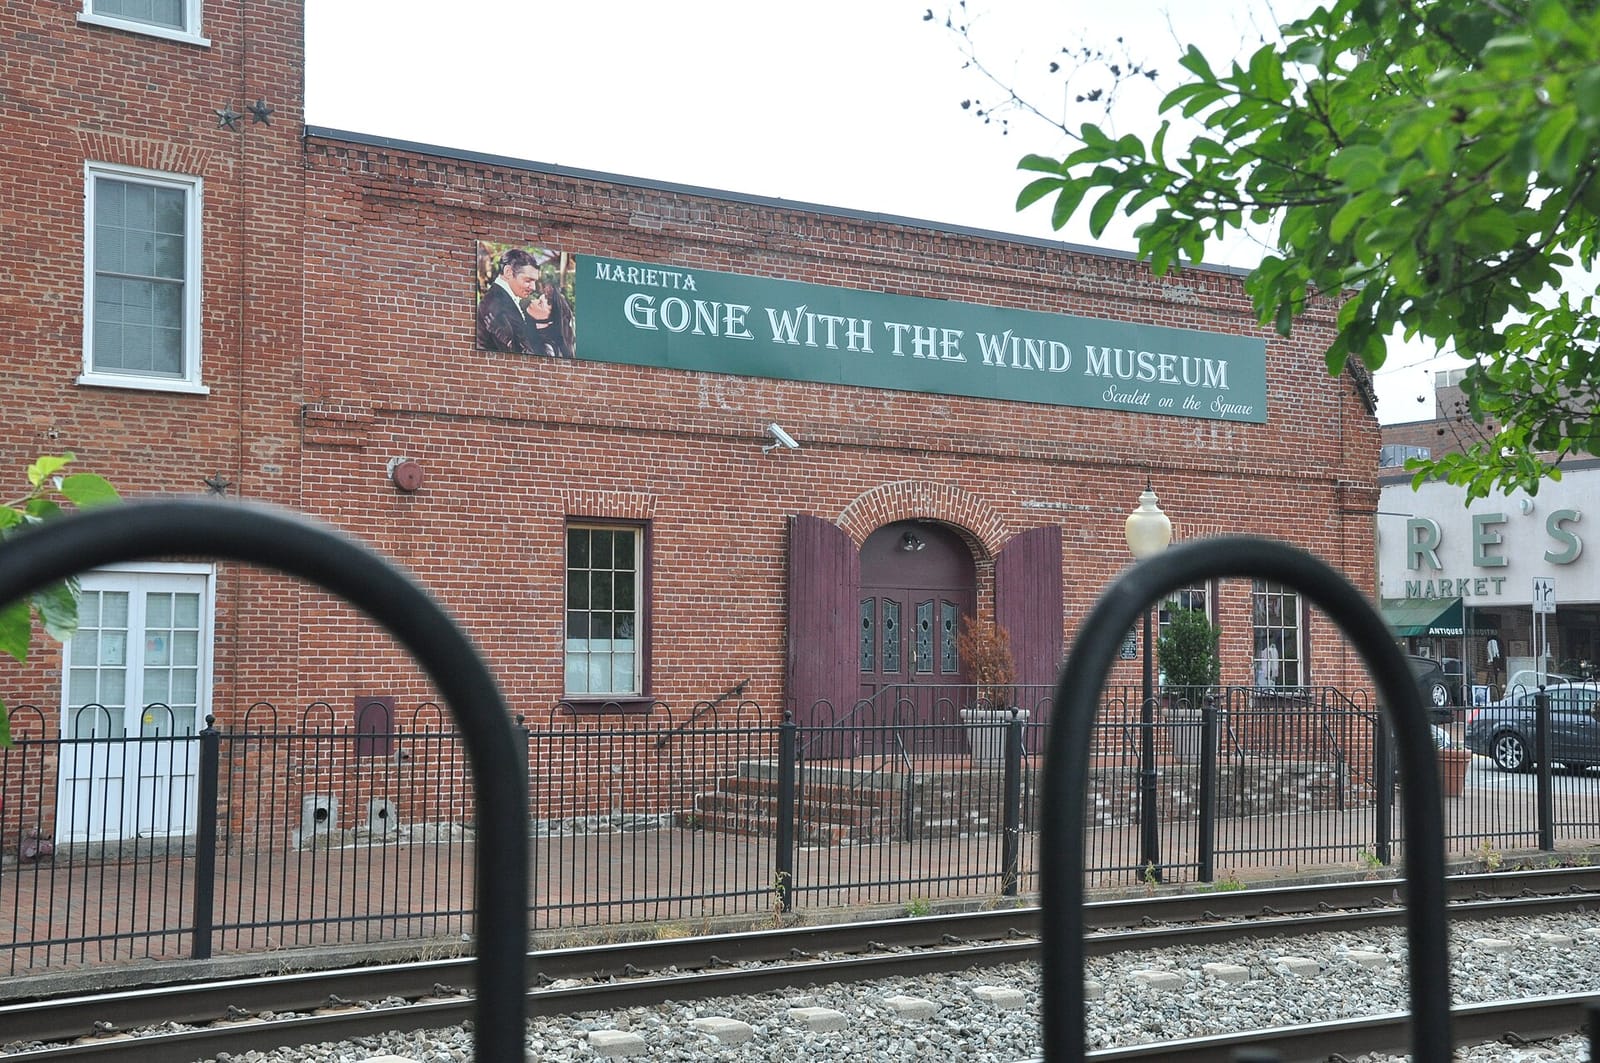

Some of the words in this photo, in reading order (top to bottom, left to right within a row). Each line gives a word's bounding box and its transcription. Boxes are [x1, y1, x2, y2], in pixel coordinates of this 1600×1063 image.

[595, 262, 698, 292] MARIETTA
[623, 293, 755, 341] GONE
[764, 304, 874, 354] WITH
[884, 319, 968, 363] THE
[975, 329, 1073, 374] WIND
[1083, 345, 1230, 391] MUSEUM
[1102, 384, 1150, 407] Scarlett
[1158, 396, 1175, 408] on
[1183, 394, 1202, 411] the
[1209, 399, 1253, 418] Square
[1406, 498, 1584, 571] RE'S
[1405, 576, 1507, 599] MARKET
[1428, 627, 1464, 636] ANTIQUES
